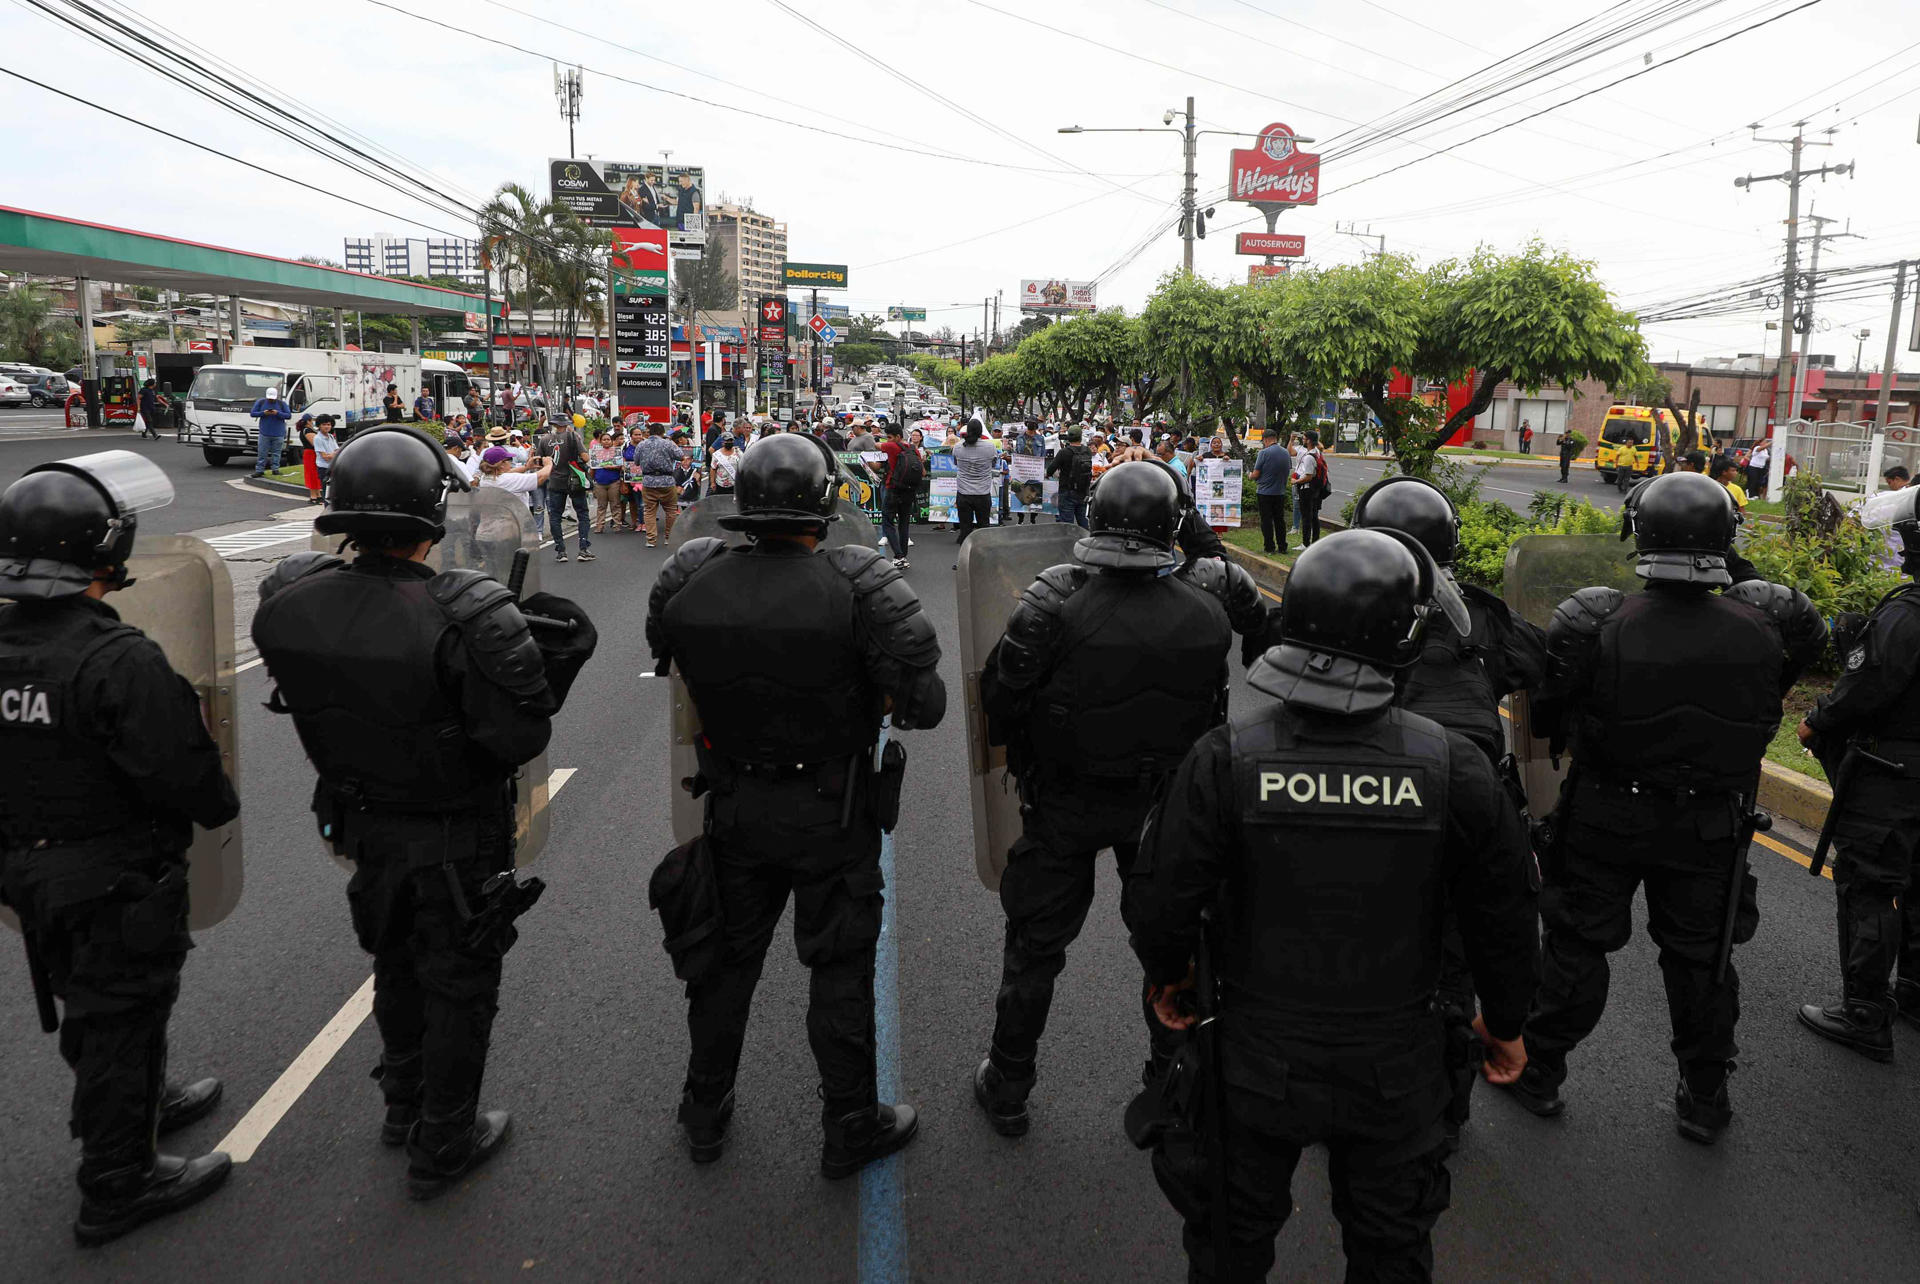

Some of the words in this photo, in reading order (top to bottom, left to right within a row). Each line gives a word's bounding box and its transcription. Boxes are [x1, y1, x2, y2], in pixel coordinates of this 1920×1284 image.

[1237, 166, 1315, 200] Wendy's
[1245, 238, 1302, 249] AUTOSERVICIO
[786, 269, 844, 282] Dollarcity
[616, 312, 635, 320] Diesel
[617, 330, 639, 338] Regular
[423, 350, 477, 361] SUBWAY
[617, 346, 634, 354] Super
[621, 379, 662, 387] Autoservicio
[1260, 772, 1422, 807] POLICIA
